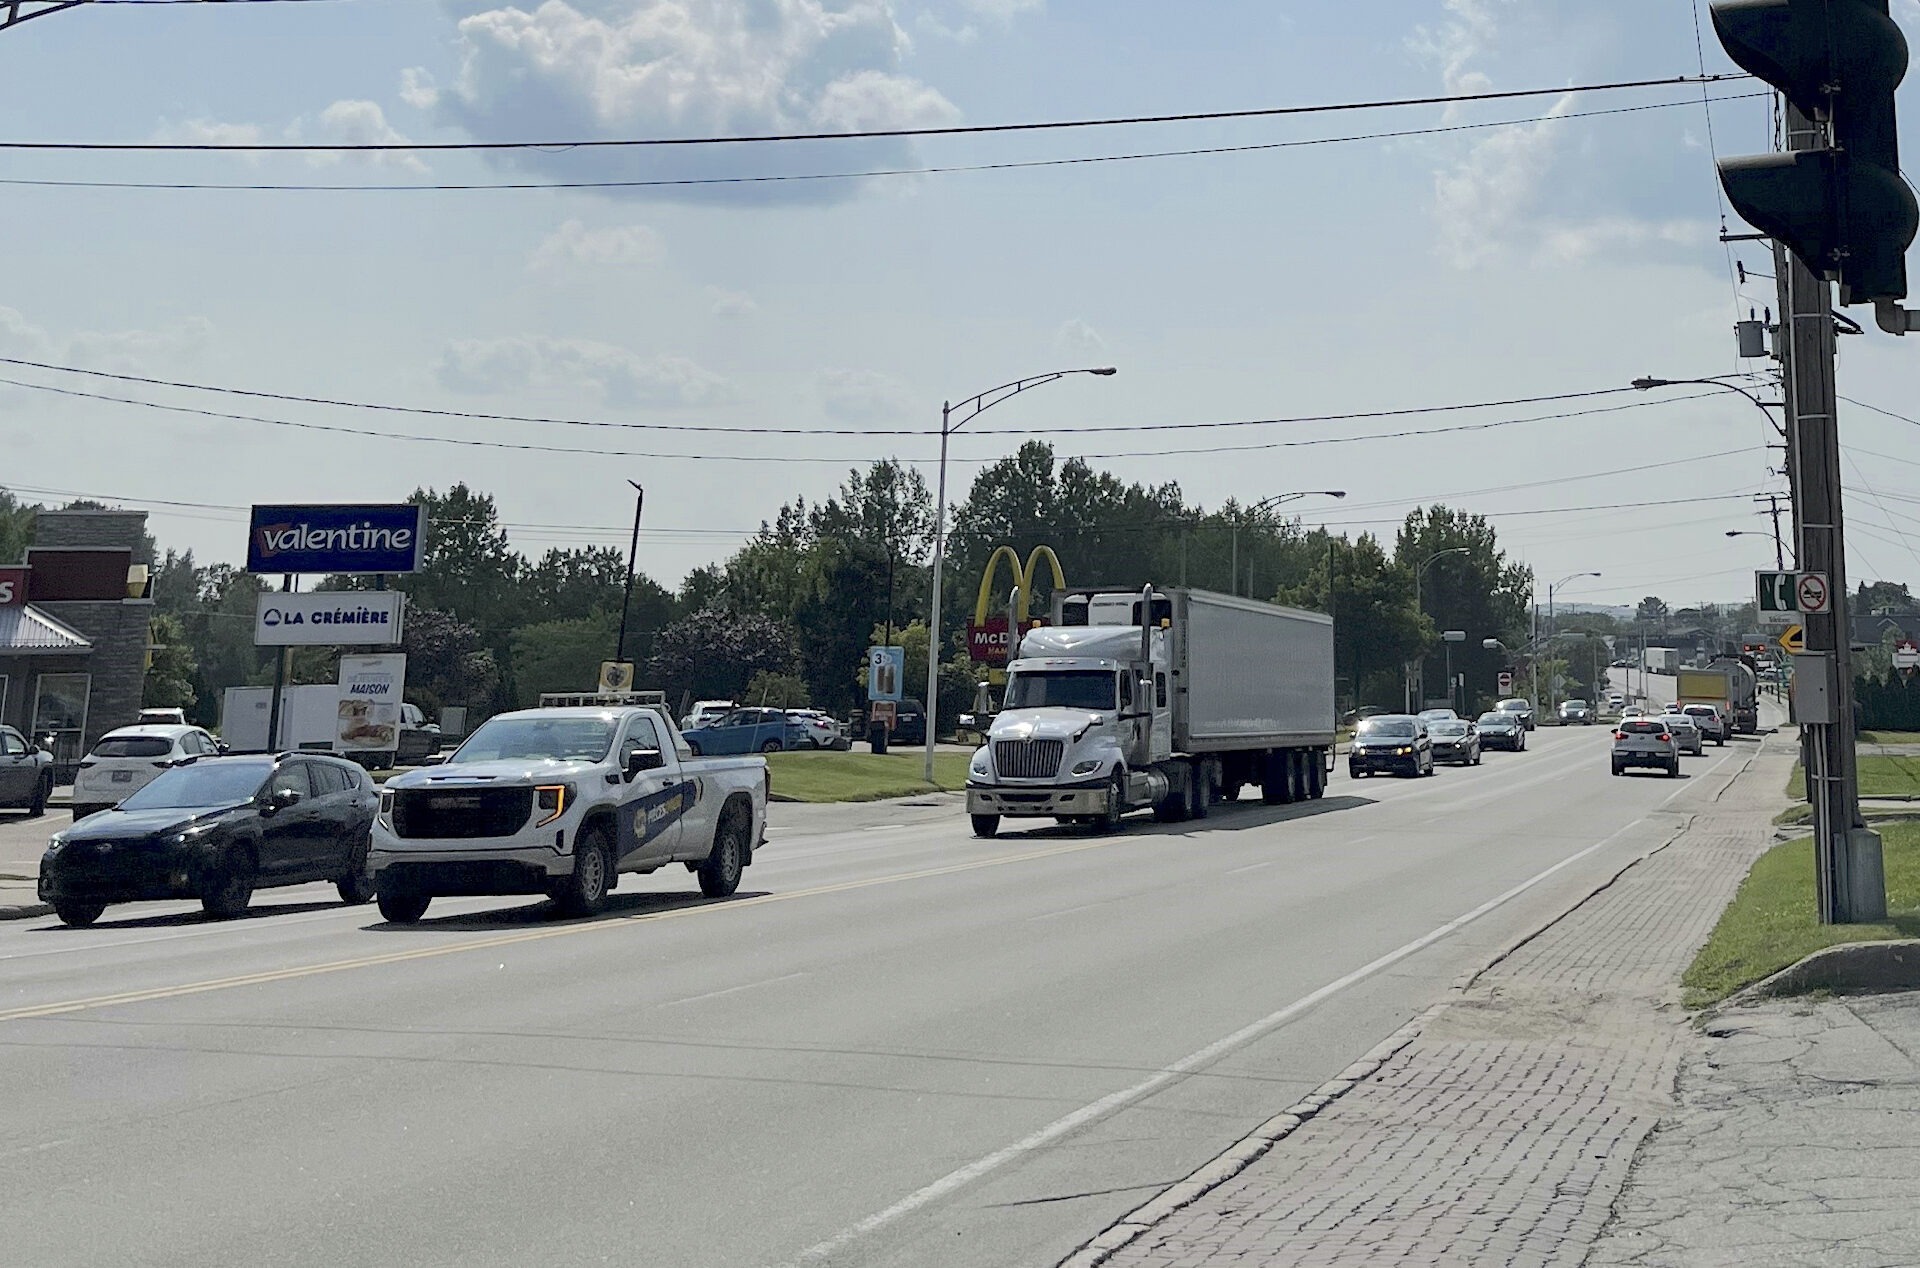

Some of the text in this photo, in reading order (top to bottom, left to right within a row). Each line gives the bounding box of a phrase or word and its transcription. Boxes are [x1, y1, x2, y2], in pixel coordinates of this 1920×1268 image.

[263, 521, 412, 551] valentine
[284, 606, 389, 625] LA CRÉMIÈRE
[349, 683, 390, 695] MAISON
